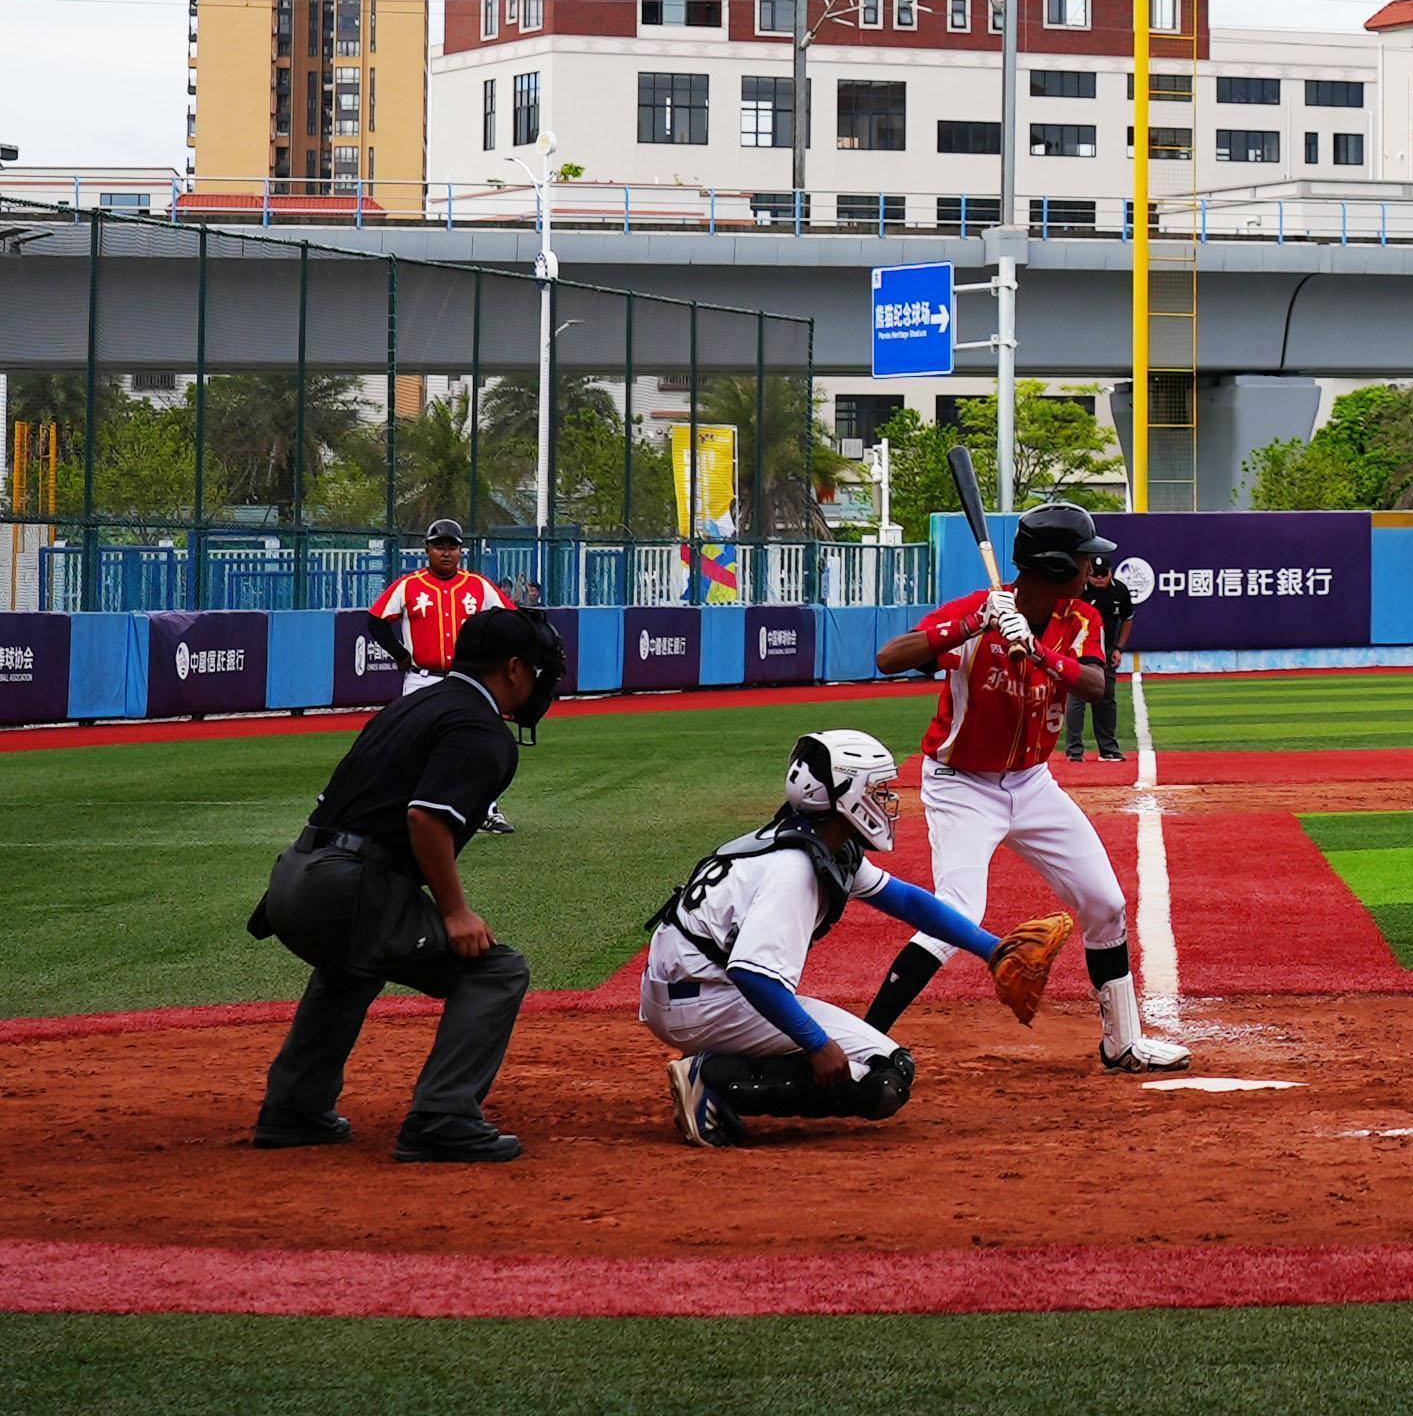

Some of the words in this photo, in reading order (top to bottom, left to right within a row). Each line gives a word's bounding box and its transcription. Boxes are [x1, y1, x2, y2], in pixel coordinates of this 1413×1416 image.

[1158, 568, 1332, 597] 中國信託銀行
